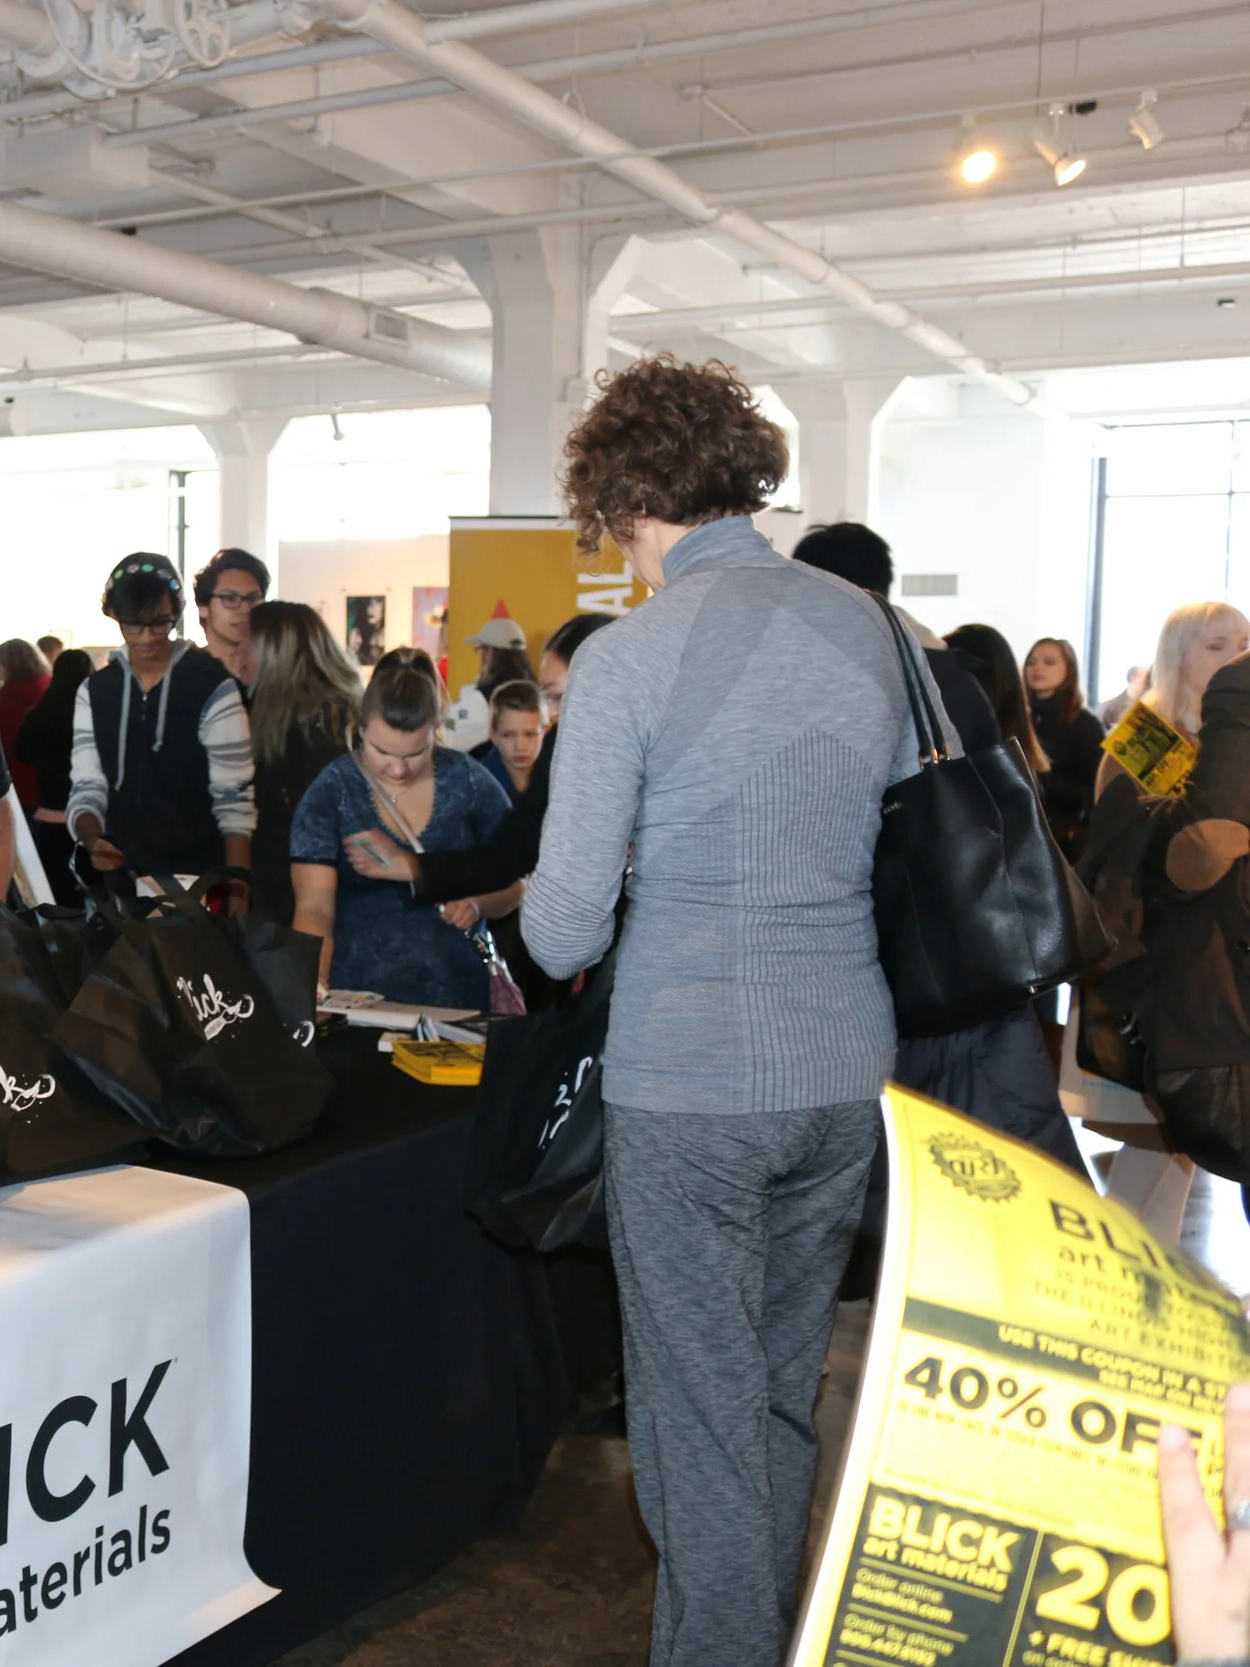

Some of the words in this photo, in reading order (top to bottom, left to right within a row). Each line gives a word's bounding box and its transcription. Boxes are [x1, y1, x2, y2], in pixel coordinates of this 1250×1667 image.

[1058, 1245, 1106, 1273] art
[998, 1323, 1036, 1350] USE
[1037, 1333, 1080, 1362] THIS
[1080, 1346, 1161, 1383] COUPON
[1162, 1368, 1185, 1389] IN
[904, 1354, 1048, 1429] 40%
[1069, 1399, 1203, 1456] OF
[862, 1536, 899, 1561] art
[901, 1546, 1009, 1593] materials
[868, 1495, 1021, 1573] BLICK
[856, 1567, 899, 1591] Order
